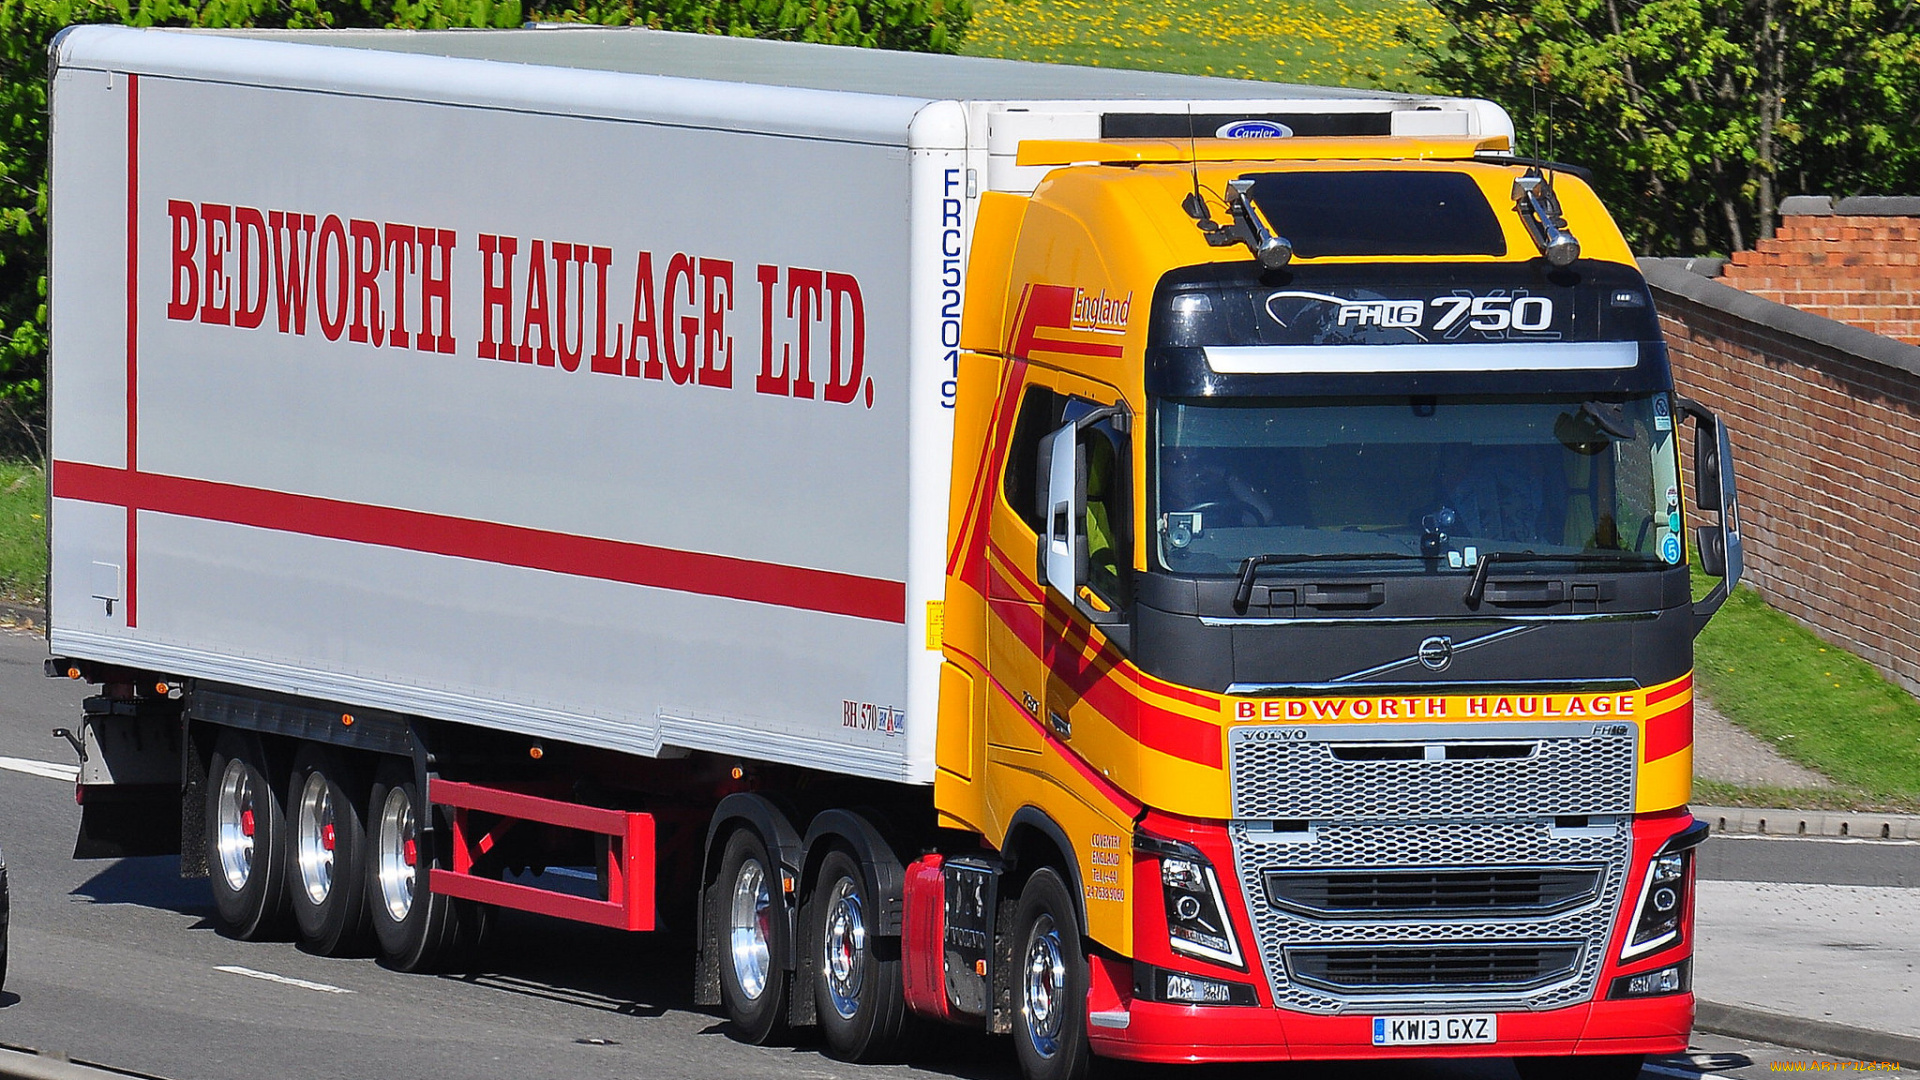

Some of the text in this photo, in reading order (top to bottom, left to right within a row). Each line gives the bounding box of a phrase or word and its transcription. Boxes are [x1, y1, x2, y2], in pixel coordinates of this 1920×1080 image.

[1234, 128, 1275, 139] Carrier
[940, 168, 962, 408] FRC52019
[167, 198, 875, 410] BEDWORTH HAULAGE LTD.
[1073, 287, 1133, 331] England
[1338, 296, 1554, 331] FH16 750
[843, 700, 858, 728] BH
[861, 703, 877, 731] 570
[1234, 695, 1635, 721] BEDWORTH HAULAGE
[1239, 729, 1307, 741] VOLVO
[1091, 833, 1120, 849] COVENTRY
[1092, 851, 1119, 866] ENGLAND
[1392, 1018, 1489, 1041] KW13 GXZ
